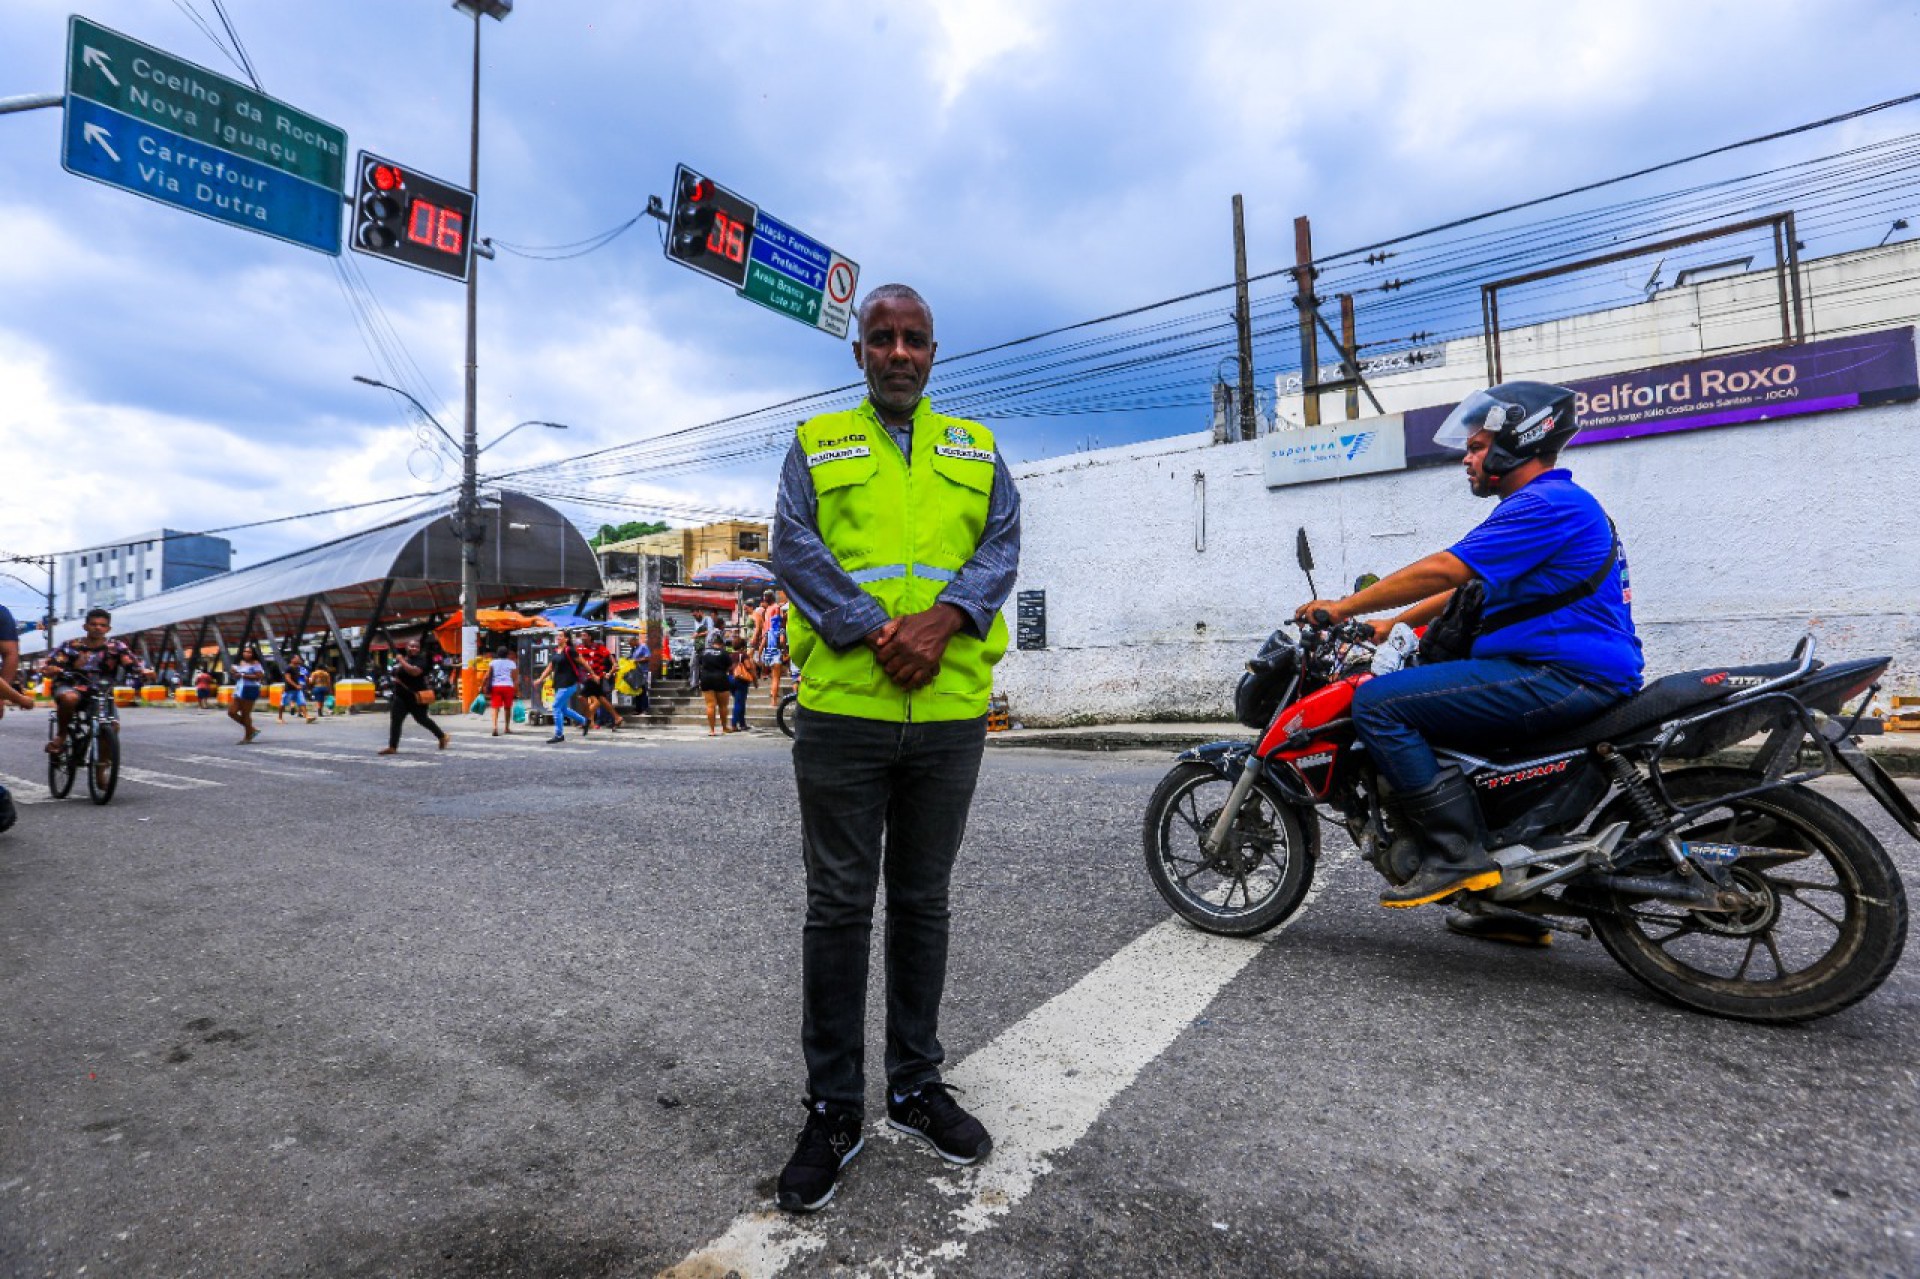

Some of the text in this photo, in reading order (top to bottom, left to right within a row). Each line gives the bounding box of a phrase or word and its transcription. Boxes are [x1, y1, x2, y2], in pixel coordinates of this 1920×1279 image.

[130, 85, 297, 162] Nova Iguaçu
[132, 57, 340, 155] Coelho da Rocha
[138, 135, 268, 192] Carrefour
[138, 162, 268, 221] Via Dutra
[408, 199, 463, 256] 06
[756, 219, 787, 243] Estação
[771, 251, 810, 280] Prefeitura
[771, 291, 788, 307] Lote
[1575, 363, 1798, 417] Belford Roxo
[1618, 411, 1642, 422] Jorge
[1665, 404, 1694, 415] Costa
[1696, 401, 1715, 410] dos
[1716, 396, 1753, 407] Santos
[1765, 386, 1800, 401] JOCA)
